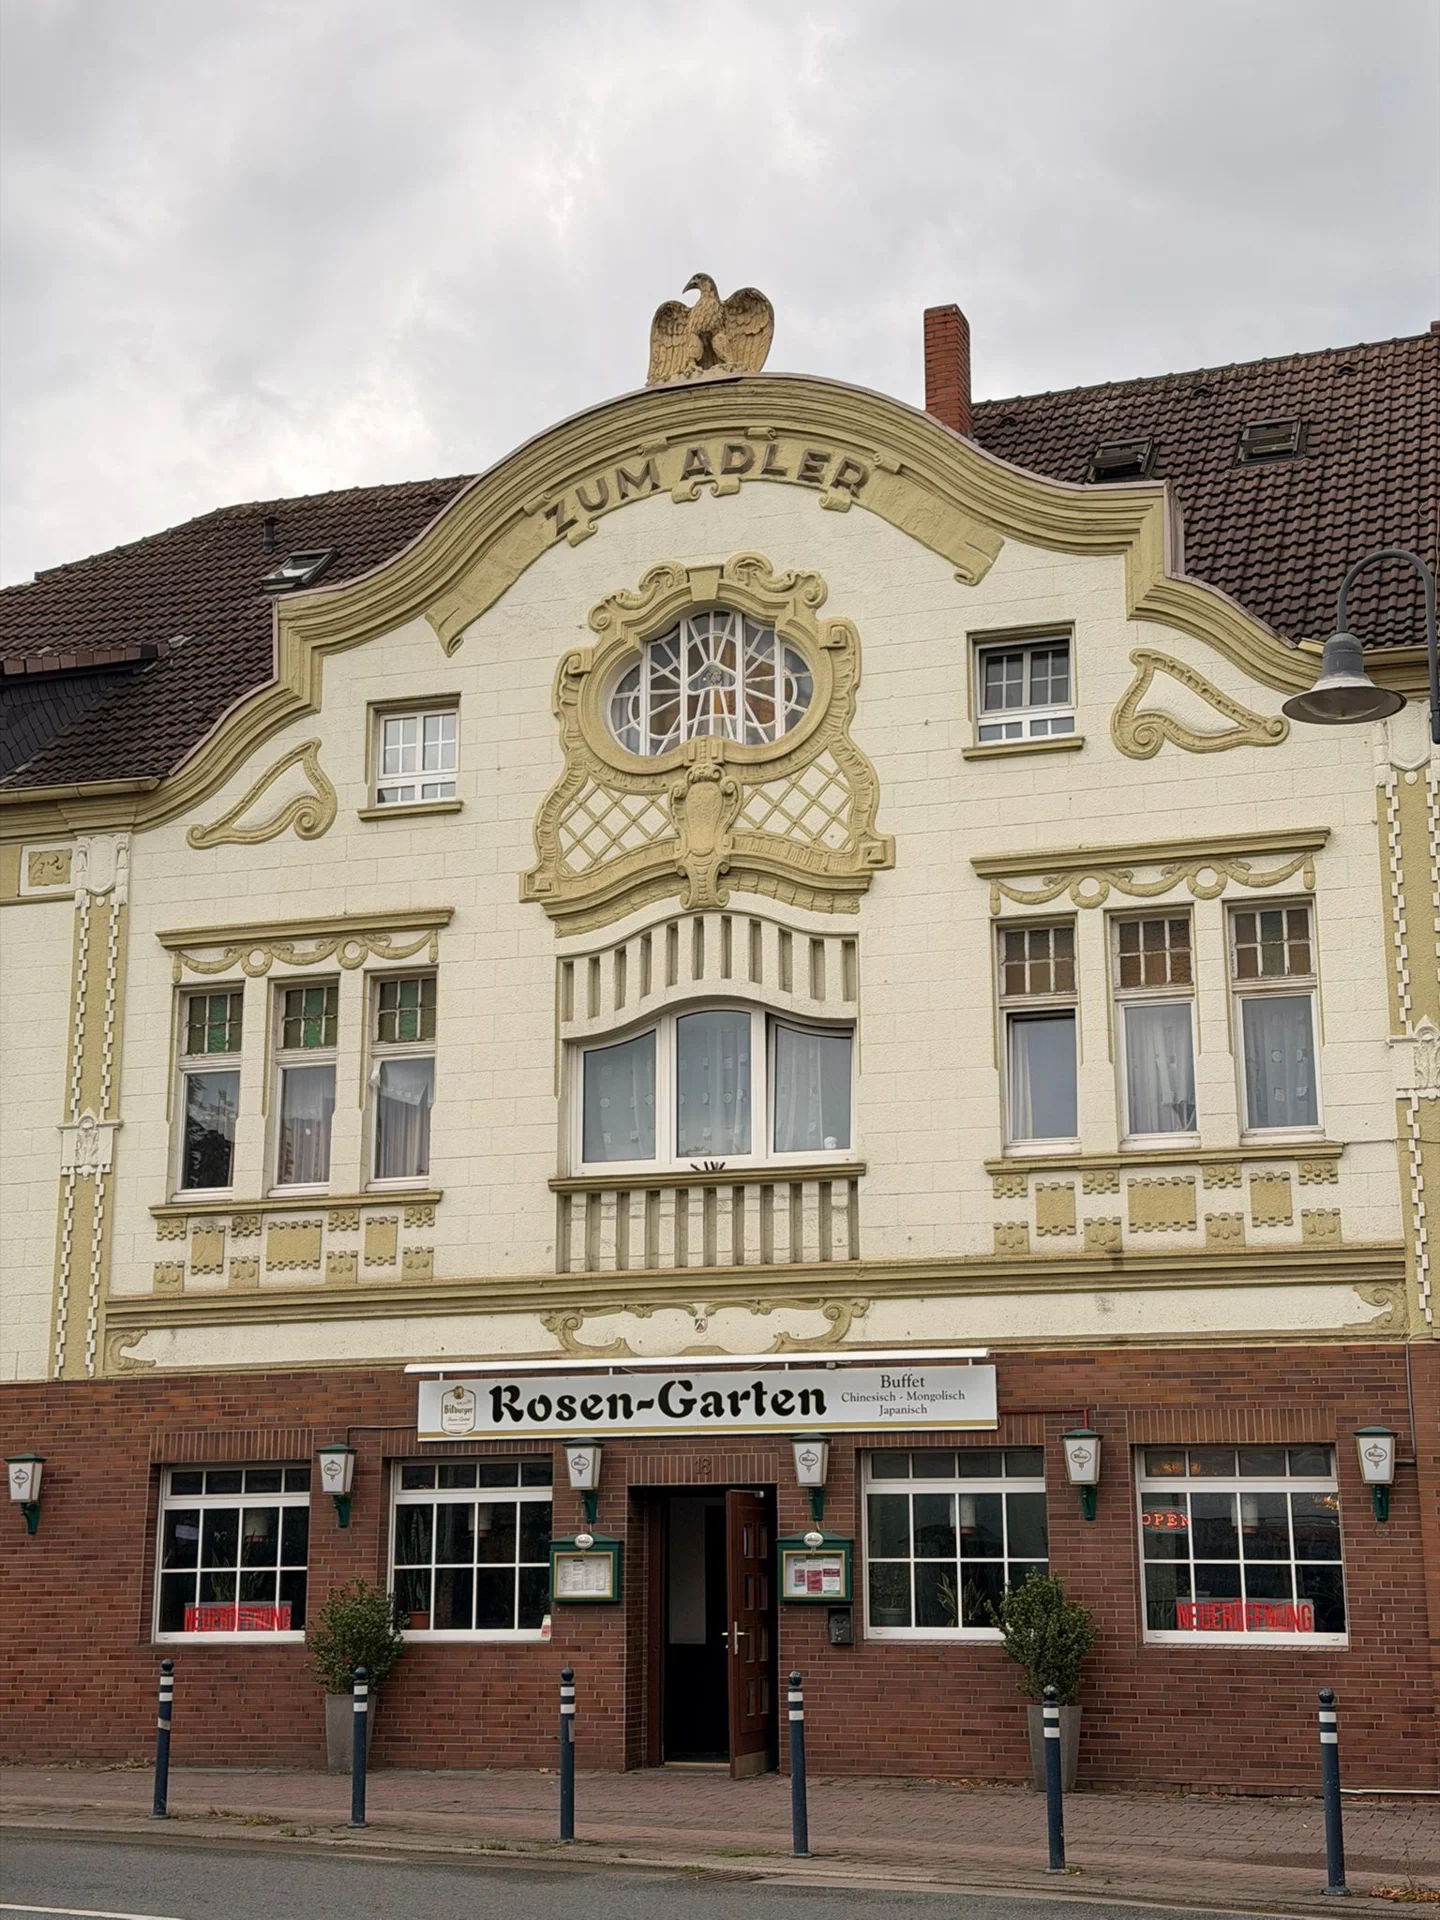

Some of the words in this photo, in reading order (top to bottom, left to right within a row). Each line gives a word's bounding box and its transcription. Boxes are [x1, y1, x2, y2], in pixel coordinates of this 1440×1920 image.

[544, 460, 660, 536] ZUM
[680, 443, 870, 498] ADLER
[880, 1374, 925, 1388] Buffet
[488, 1380, 827, 1423] Rosen-Garten
[841, 1392, 896, 1402] Chinesisch
[906, 1390, 965, 1402] Mongolisch
[879, 1404, 928, 1416] Japanisch
